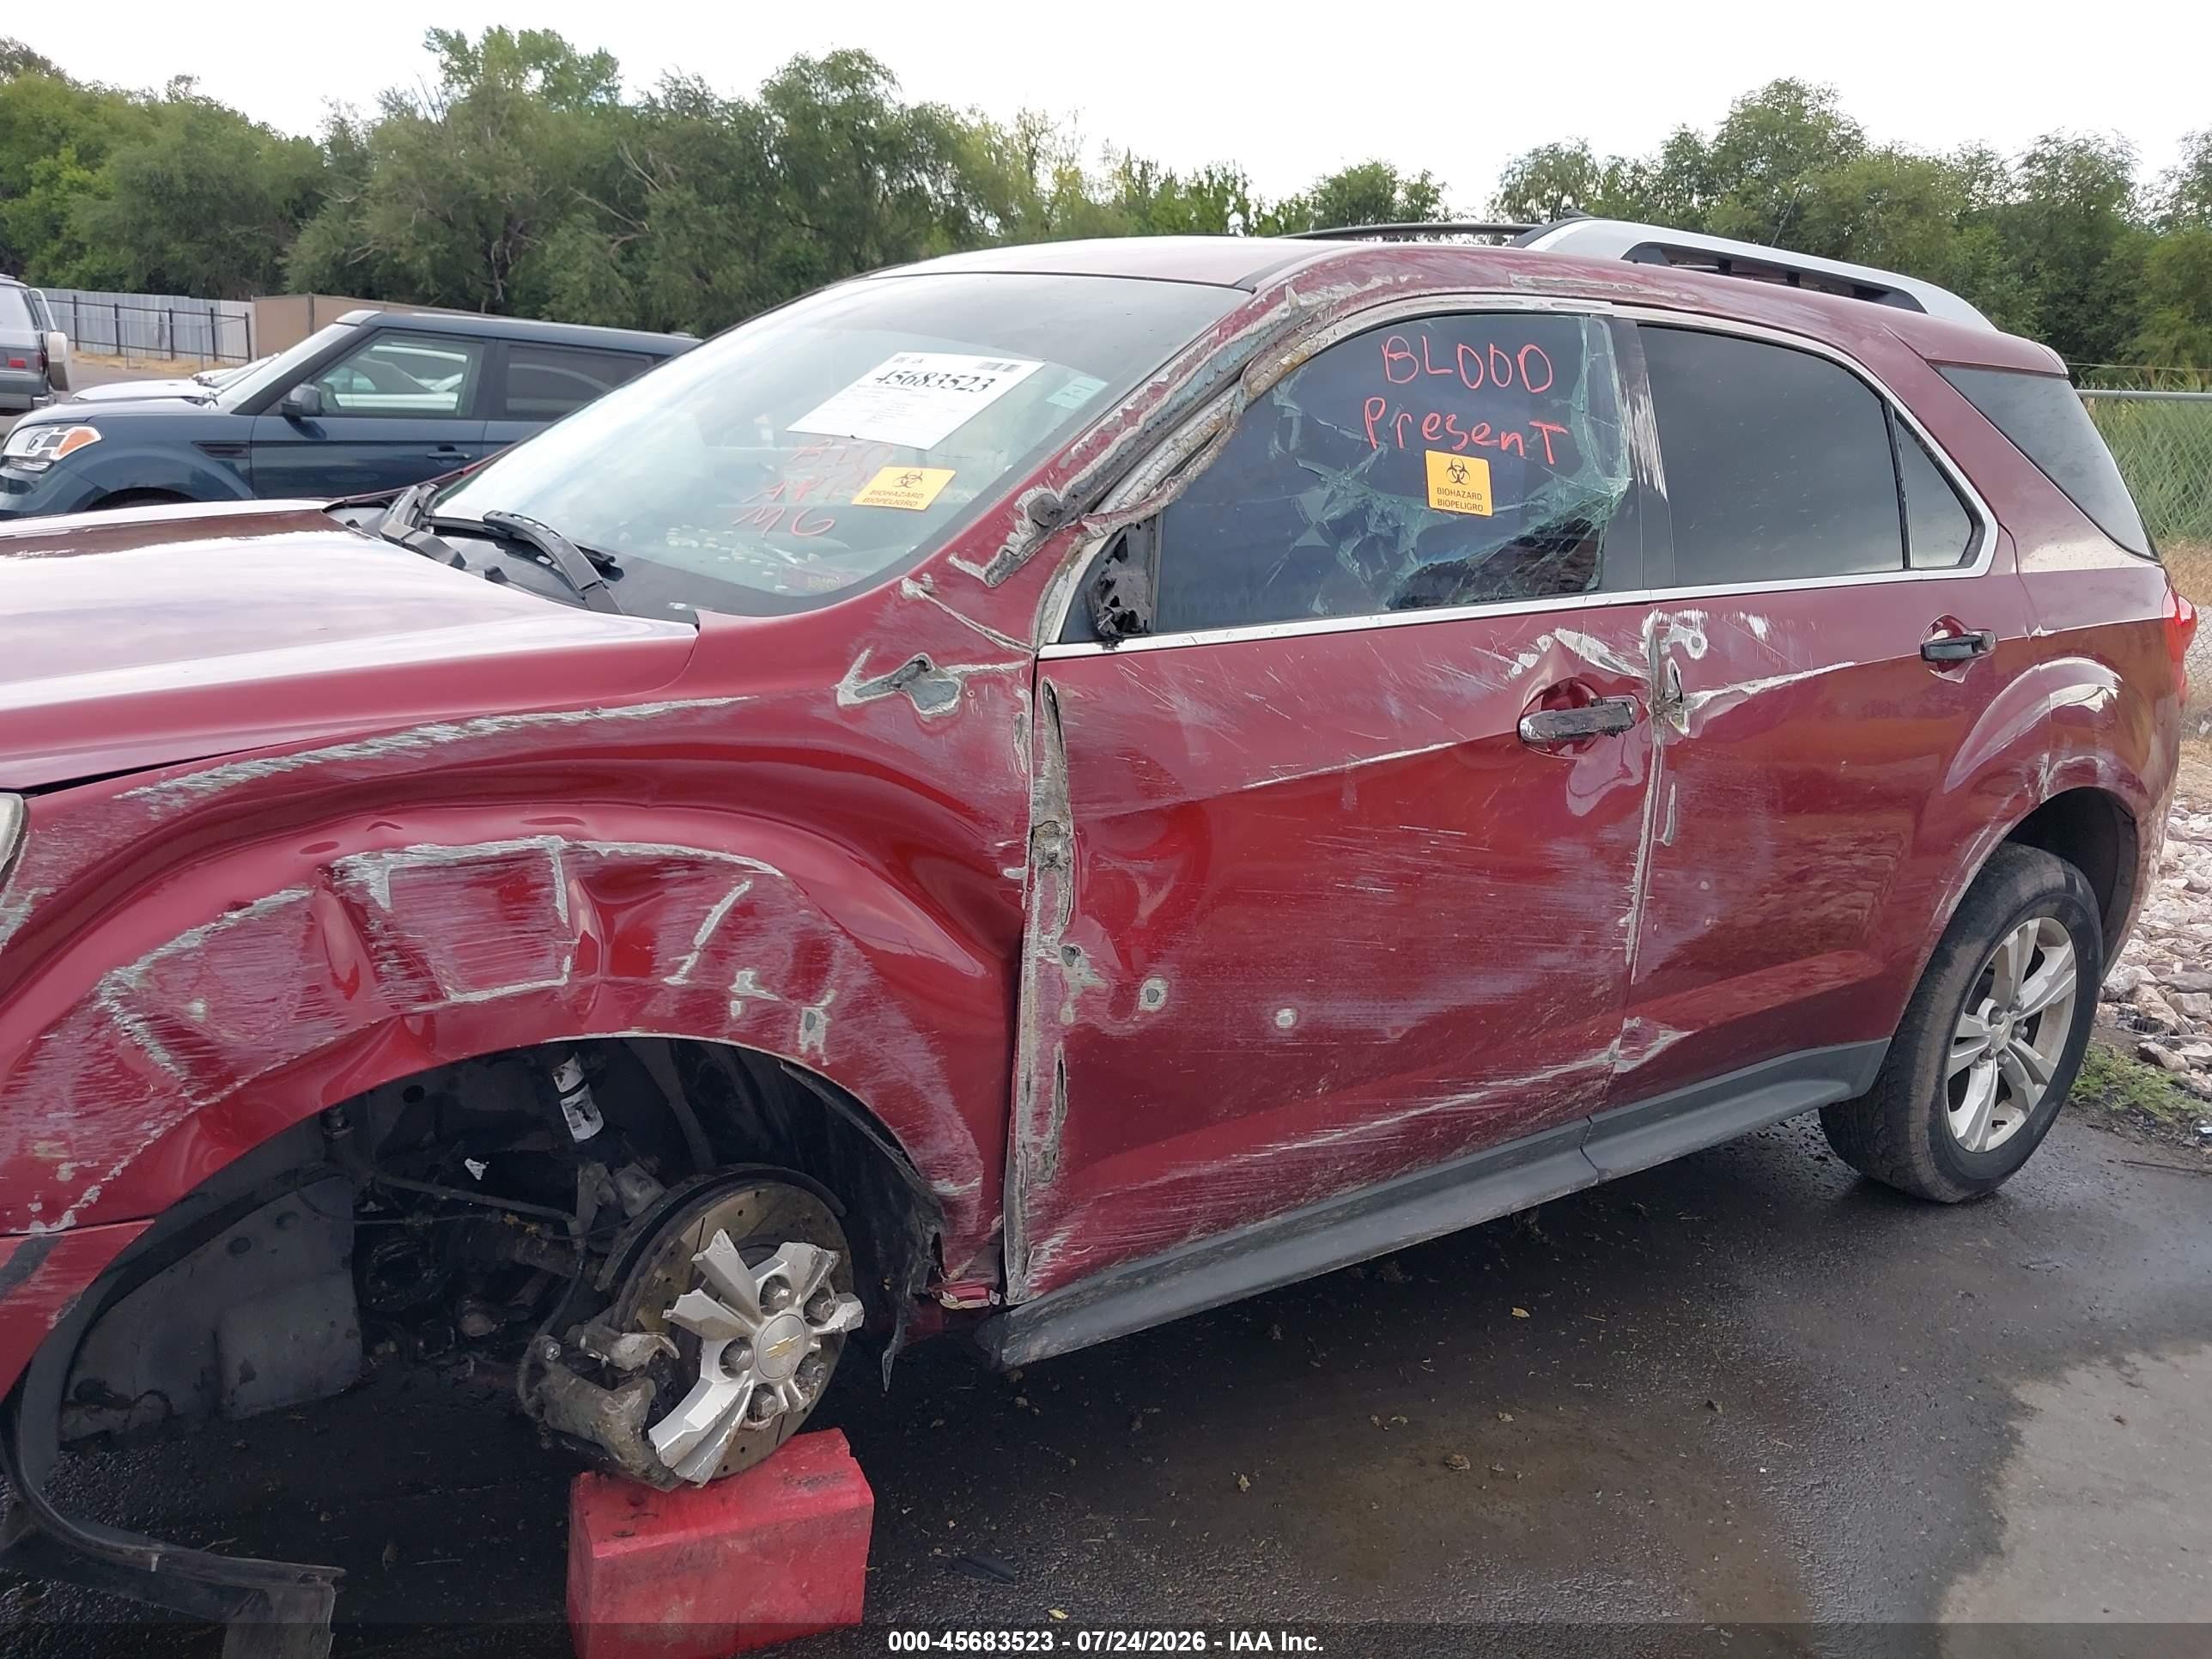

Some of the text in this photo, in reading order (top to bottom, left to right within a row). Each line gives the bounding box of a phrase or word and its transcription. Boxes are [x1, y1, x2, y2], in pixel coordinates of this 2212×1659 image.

[1381, 336, 1553, 393] BLOOD
[875, 370, 996, 392] 45683523
[869, 489, 925, 499] BIOHAZARD
[1437, 487, 1483, 501] BIOHAZARD
[862, 497, 918, 507] BIOPELIGRO
[1437, 498, 1484, 512] BIOPELIGRO
